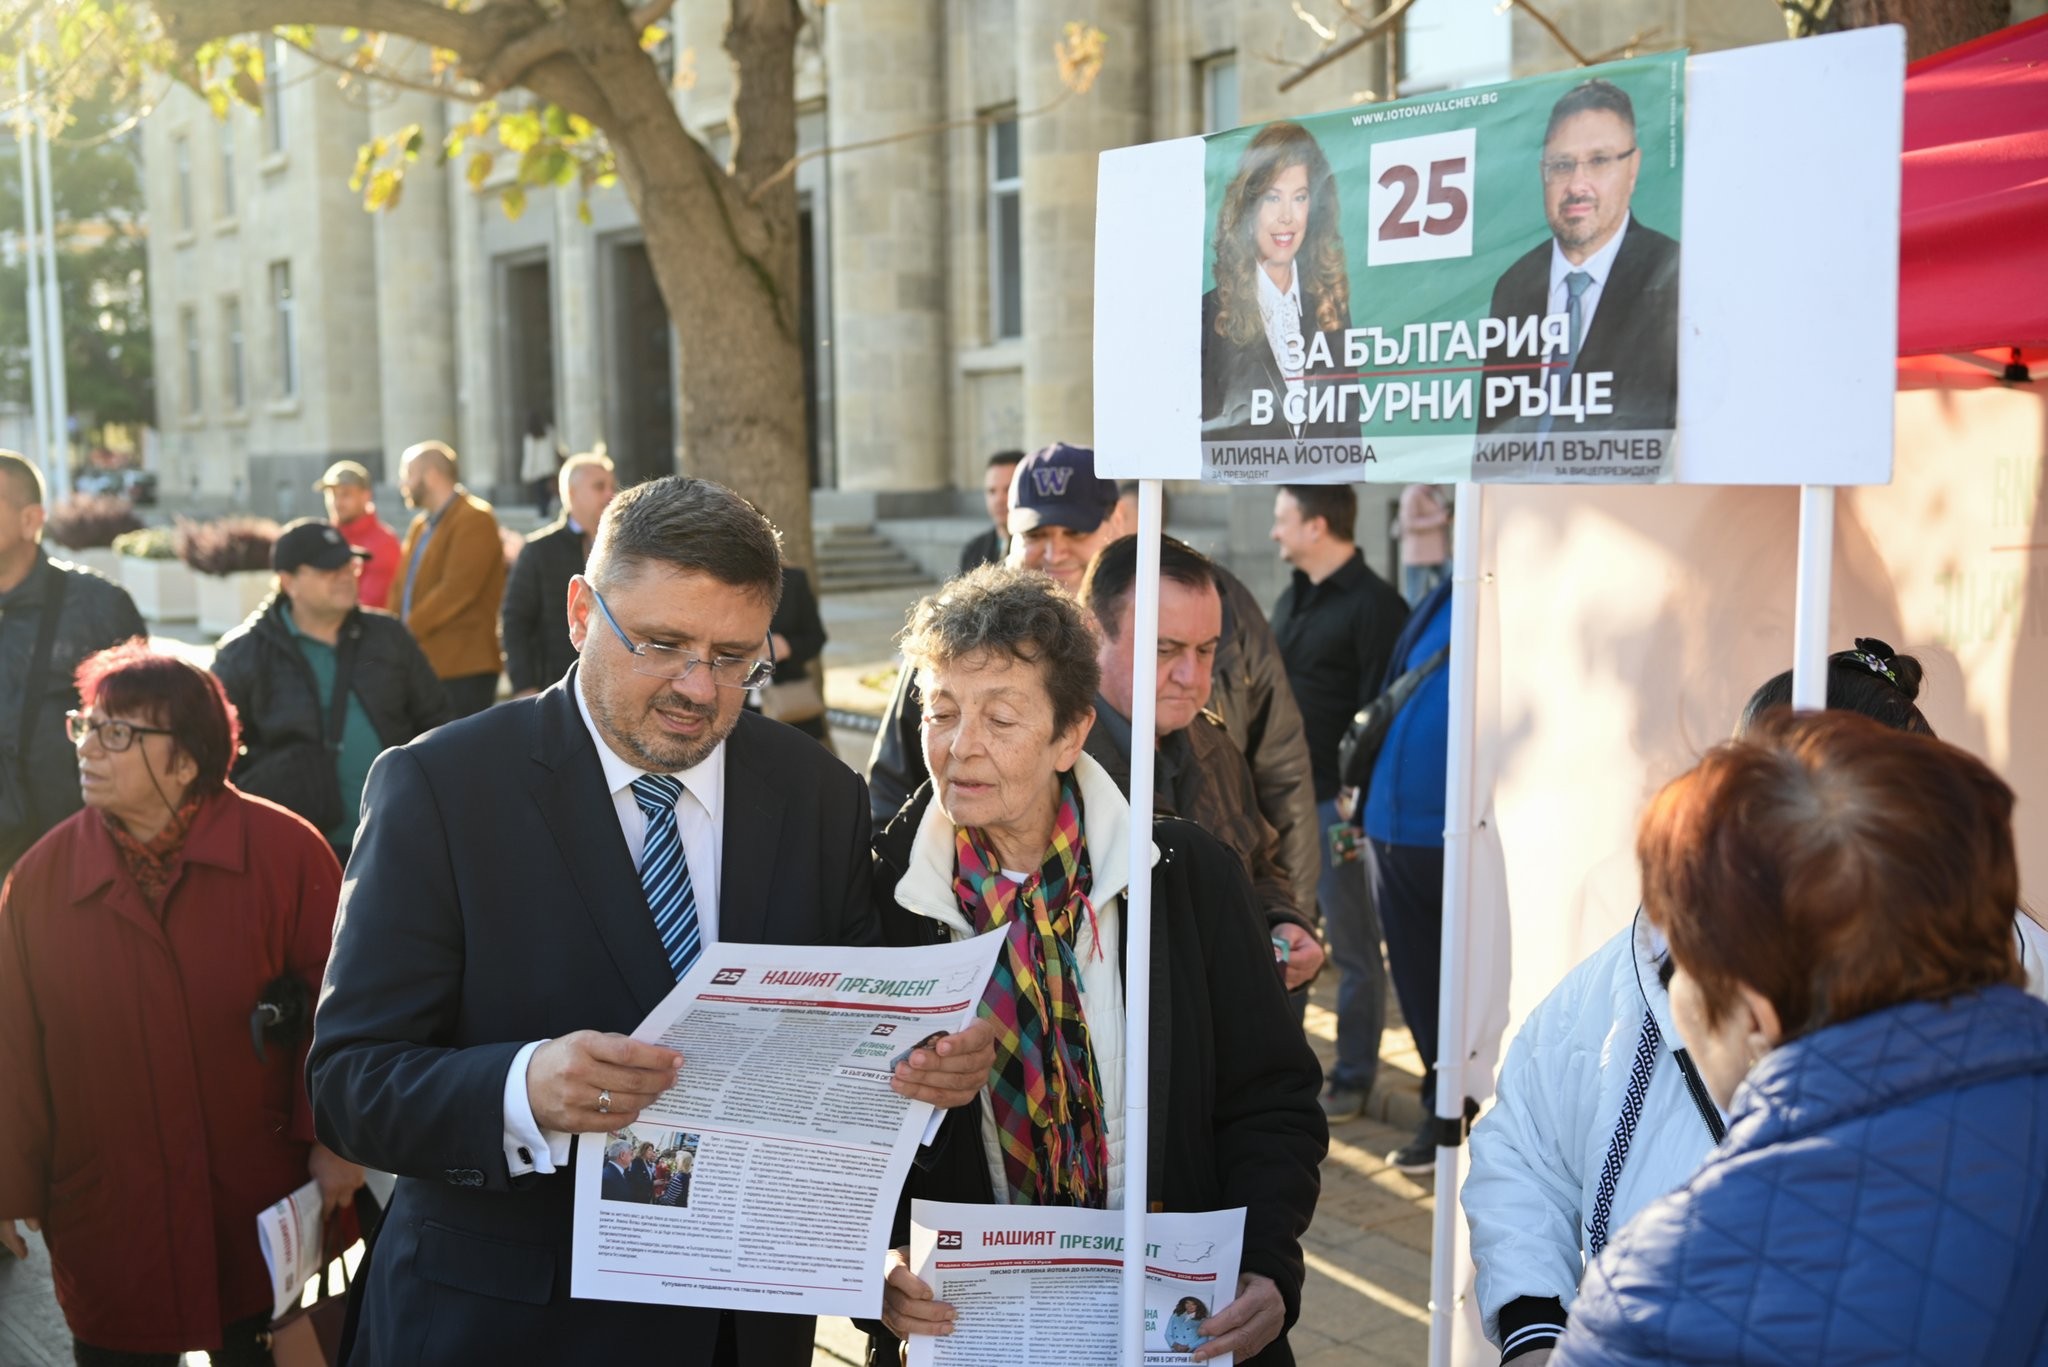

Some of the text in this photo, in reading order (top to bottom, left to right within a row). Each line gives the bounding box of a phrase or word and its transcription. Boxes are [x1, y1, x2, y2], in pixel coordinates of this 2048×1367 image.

[1352, 92, 1498, 126] WWW.IOTOVAVALCHEV.BG
[1378, 157, 1468, 241] 25
[1284, 312, 1571, 371] ЗА БЪЛГАРИЯ
[1250, 371, 1614, 426] В СИГУРНИ РЪЦЕ
[1211, 440, 1377, 466] ИЛИЯНА ЙОТОВА
[1476, 439, 1662, 462] КИРИЛ ВЪЛЧЕВ
[1223, 470, 1269, 480] ПРЕЗИДЕНТ
[1569, 466, 1661, 477] ВИЦЕПРЕЗИДЕНТ
[1032, 467, 1074, 497] W
[715, 971, 742, 982] 25
[760, 970, 939, 997] НАШИЯТ ПРЕЗИДЕНТ
[874, 1025, 894, 1034] 25
[853, 1048, 888, 1057] ЙОТОВА
[859, 1041, 896, 1051] ИЛИЯНА
[848, 1069, 875, 1078] БЪЛГАРИЯ
[939, 1234, 961, 1246] 25
[982, 1231, 1056, 1247] НАШИЯТ
